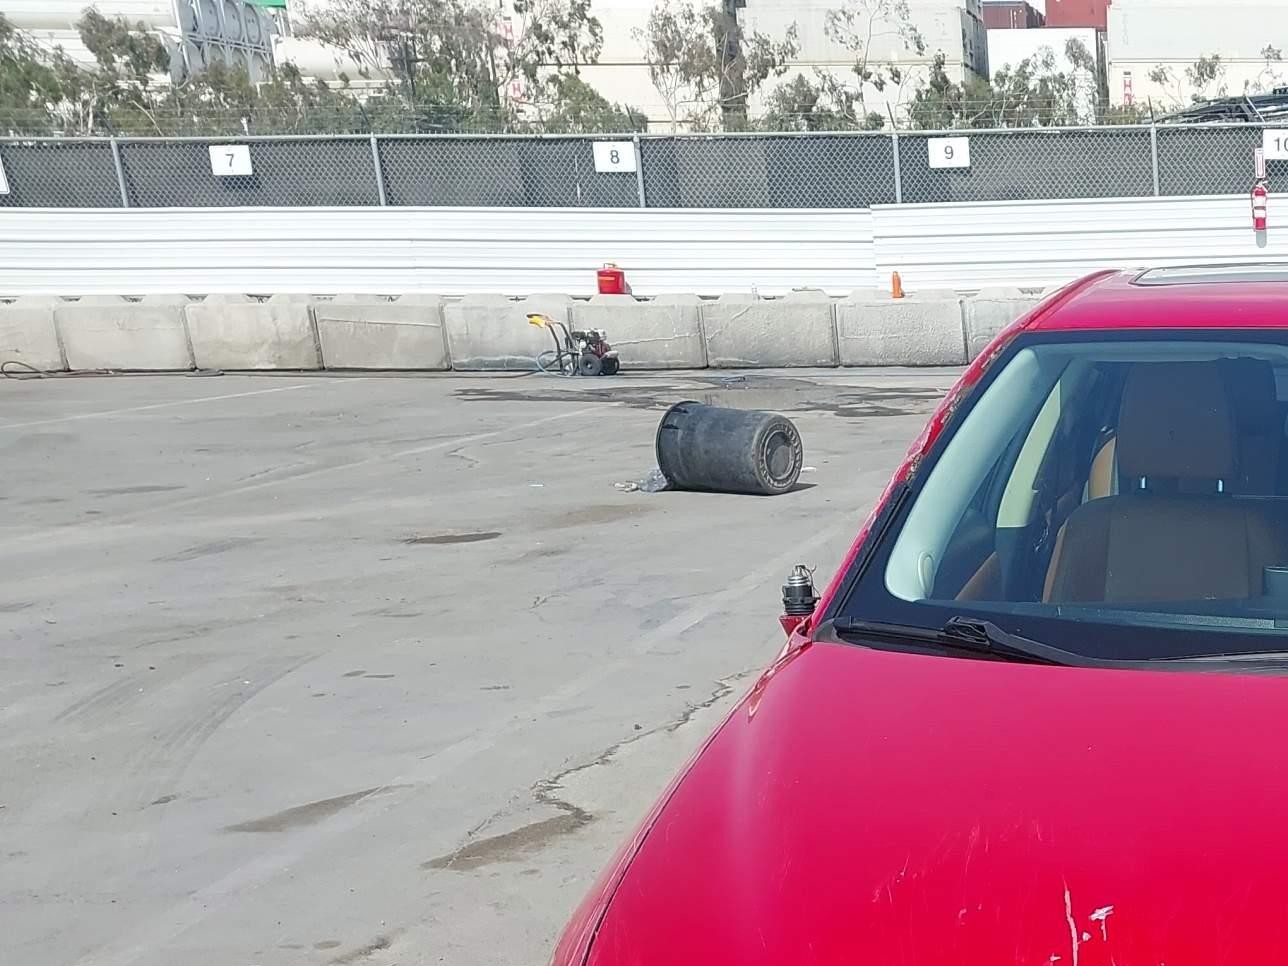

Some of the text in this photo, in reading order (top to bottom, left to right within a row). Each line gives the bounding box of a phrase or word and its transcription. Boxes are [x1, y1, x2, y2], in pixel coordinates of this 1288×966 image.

[225, 153, 235, 167] 7
[610, 151, 620, 164] 8
[944, 147, 954, 160] 9
